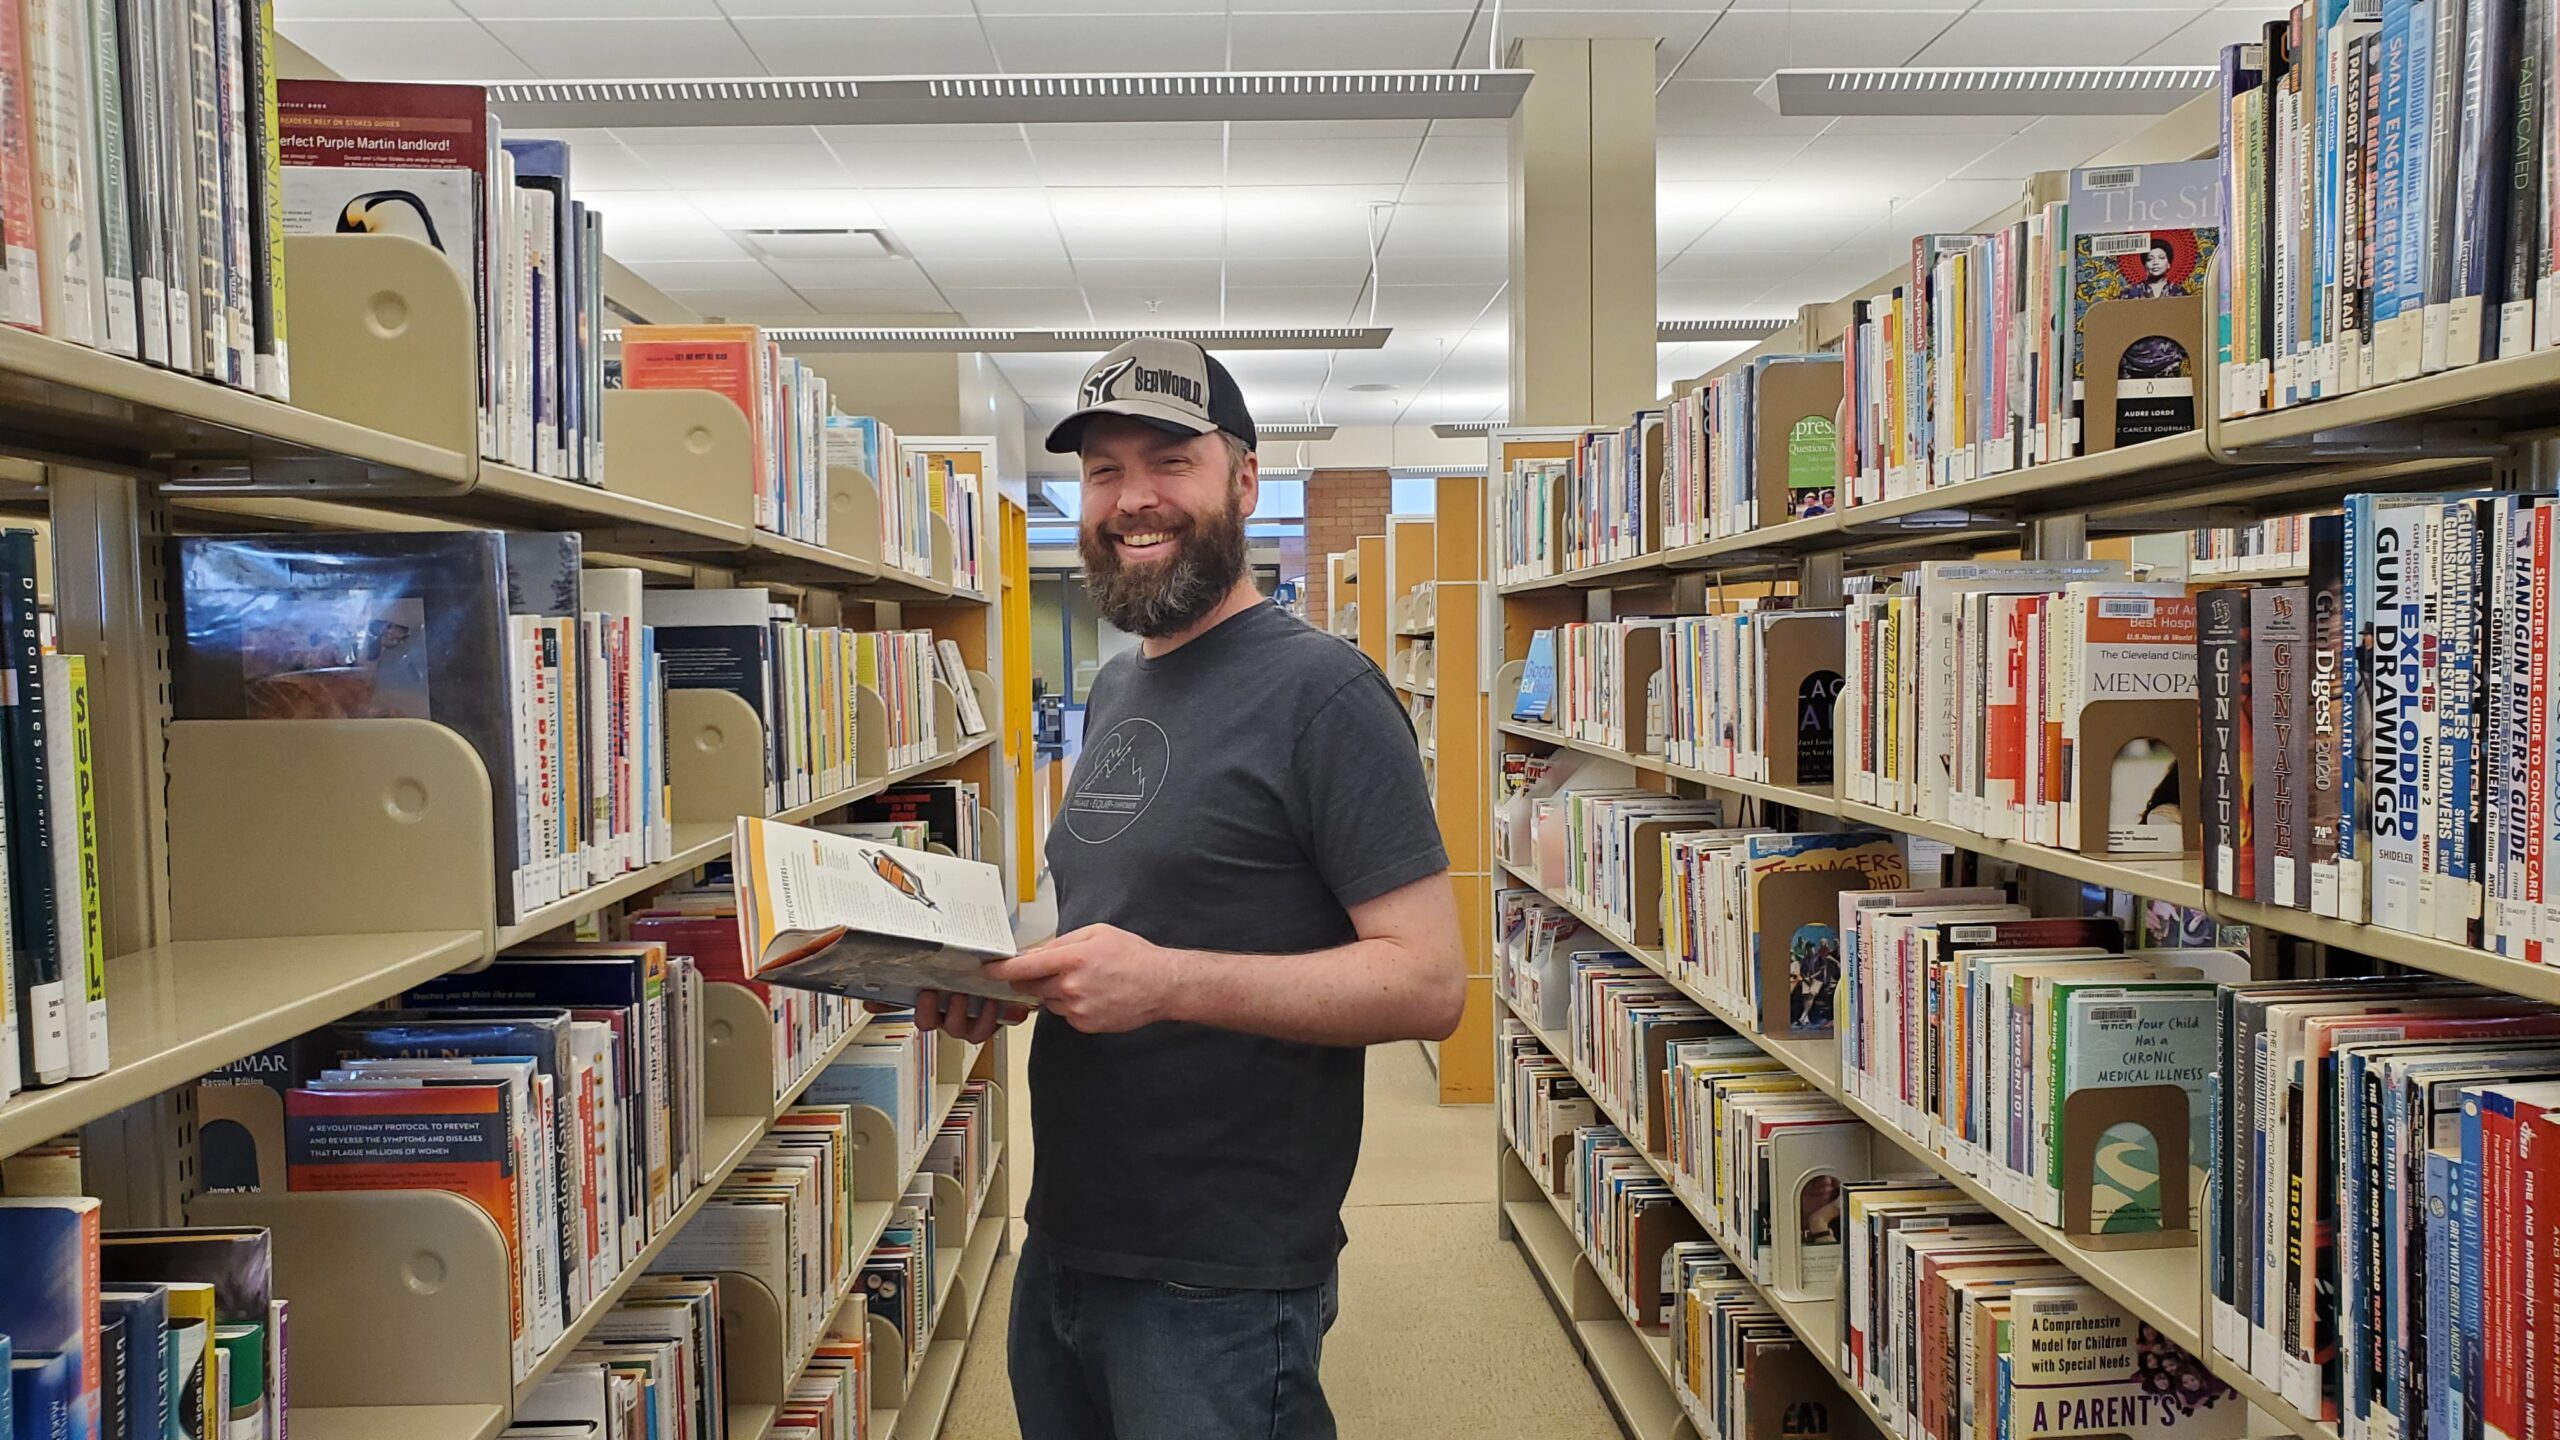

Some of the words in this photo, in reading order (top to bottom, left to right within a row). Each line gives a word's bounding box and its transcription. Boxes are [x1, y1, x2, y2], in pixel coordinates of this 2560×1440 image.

[100, 30, 116, 73] Wild
[2435, 15, 2454, 78] Hand
[2388, 37, 2402, 111] SMALL
[2410, 46, 2426, 129] HANDBOOK
[103, 79, 119, 113] and
[2346, 56, 2360, 144] PASSPORT
[2432, 86, 2450, 148] Tools
[280, 134, 314, 148] erfect
[316, 136, 354, 150] Purple
[357, 137, 395, 150] Martin
[398, 138, 450, 151] landlord!
[314, 118, 331, 126] RELY
[345, 119, 372, 127] STOKES
[374, 120, 400, 128] GUIDES
[2250, 120, 2258, 167] BUILD
[2409, 133, 2423, 151] OF
[2514, 56, 2534, 190] FABRICATED
[105, 120, 120, 186] Broken
[2346, 149, 2357, 172] TO
[2384, 116, 2402, 211] ENGINE
[2406, 157, 2422, 207] MODEL
[2344, 178, 2357, 235] WORLD
[1916, 250, 1924, 285] Paleo
[2344, 240, 2355, 287] BAND
[2381, 219, 2398, 295] REPAIR
[2404, 212, 2420, 285] ROCKETRY
[1914, 288, 1925, 348] Approach
[2342, 293, 2354, 329] RAD
[2412, 523, 2420, 549] GUN
[2496, 512, 2504, 526] The
[2344, 507, 2354, 586] CARBINES
[2376, 526, 2400, 611] GUN
[2442, 516, 2458, 644] GUNSMITHING:
[2456, 509, 2472, 660] GUNSMITHING:
[2344, 592, 2354, 612] OF
[2424, 592, 2437, 623] THE
[2495, 596, 2502, 604] of
[2514, 556, 2531, 676] HANDGUN
[2534, 568, 2545, 648] SHOOTER'S
[2101, 650, 2118, 660] The
[2122, 650, 2168, 660] Cleveland
[2172, 651, 2198, 660] Clinic
[2344, 618, 2354, 650] THE
[2492, 608, 2503, 676] COMBAT
[21, 577, 44, 748] Dragonflies
[2092, 672, 2198, 693] MENOPA
[2272, 642, 2292, 719] GUN
[2344, 657, 2352, 685] U.S.
[2422, 633, 2437, 712] AR-15
[2533, 653, 2544, 692] BIBLE
[2440, 651, 2456, 720] PISTOLS
[2455, 668, 2471, 740] RIFLES
[2342, 691, 2352, 760] CAVALRY
[2375, 626, 2398, 837] DRAWINGS
[2400, 604, 2420, 842] EXPLODED
[2440, 726, 2454, 738] &
[2511, 682, 2528, 784] BUYER'S
[2531, 696, 2543, 742] GUIDE
[34, 757, 44, 770] of
[2315, 739, 2331, 791] 2020
[2422, 736, 2432, 791] Volume
[2488, 682, 2500, 808] HANDGUNNERY
[2530, 746, 2542, 766] TO
[36, 778, 47, 800] the
[2422, 796, 2432, 806] 2
[2439, 744, 2453, 840] REVOLVERS
[37, 806, 49, 848] world
[2488, 811, 2497, 828] 6th
[2510, 790, 2524, 864] GUIDE
[2528, 770, 2540, 855] CONCEALED
[2379, 848, 2414, 864] SHIDELER
[2454, 808, 2464, 868] SWEENEY
[2487, 830, 2496, 862] Edition
[44, 887, 53, 910] Jill
[780, 866, 794, 908] CONVERTERS
[786, 908, 798, 928] LYTIC
[46, 919, 55, 962] Silsby
[1930, 1028, 1938, 1072] PREGNANCY
[2014, 1012, 2022, 1090] NEWBORN
[2122, 1051, 2175, 1065] CHRONIC
[2136, 1035, 2156, 1046] Has
[2160, 1038, 2168, 1046] a
[2270, 1028, 2278, 1048] THE
[201, 1078, 232, 1086] Second
[234, 1078, 264, 1086] Edition
[1930, 1074, 1938, 1096] GUIDE
[2097, 1070, 2150, 1082] MEDICAL
[2155, 1068, 2203, 1081] ILLNESS
[309, 1124, 315, 1132] A
[316, 1124, 384, 1132] REVOLUTIONARY
[385, 1123, 430, 1131] PROTOCOL
[432, 1122, 442, 1130] TO
[444, 1122, 480, 1130] PREVENT
[2370, 1107, 2378, 1127] BIG
[310, 1137, 327, 1145] AND
[366, 1136, 381, 1144] THE
[382, 1136, 426, 1144] SYMPTOMS
[446, 1134, 483, 1142] DISEASES
[366, 1148, 403, 1156] MILLIONS
[404, 1148, 416, 1156] OF
[418, 1148, 450, 1156] WOMEN
[2268, 1120, 2276, 1194] ENCYCLOPEDIA
[557, 1098, 571, 1260] Encyclopedia
[2372, 1170, 2378, 1184] OF
[2524, 1170, 2534, 1200] FIRE
[2268, 1198, 2274, 1210] OF
[2526, 1204, 2534, 1236] AND
[2372, 1232, 2380, 1291] RAILROAD
[2449, 1220, 2460, 1286] GREYWATER
[2450, 1285, 2460, 1318] GREEN
[2526, 1240, 2534, 1326] EMERGENCY
[2032, 1318, 2038, 1332] A
[2042, 1315, 2120, 1334] Comprehensive
[2032, 1338, 2063, 1352] Model
[2067, 1337, 2082, 1351] for
[2085, 1336, 2128, 1350] Children
[2032, 1359, 2054, 1372] with
[2058, 1357, 2096, 1374] Special
[2100, 1354, 2130, 1369] Needs
[2374, 1335, 2382, 1373] PLANS
[2450, 1319, 2460, 1378] LANDSCAPE
[2526, 1330, 2534, 1398] SERVICES
[2032, 1402, 2048, 1432] A
[2058, 1395, 2176, 1430] PARENT'S
[2526, 1402, 2534, 1440] INSTR
